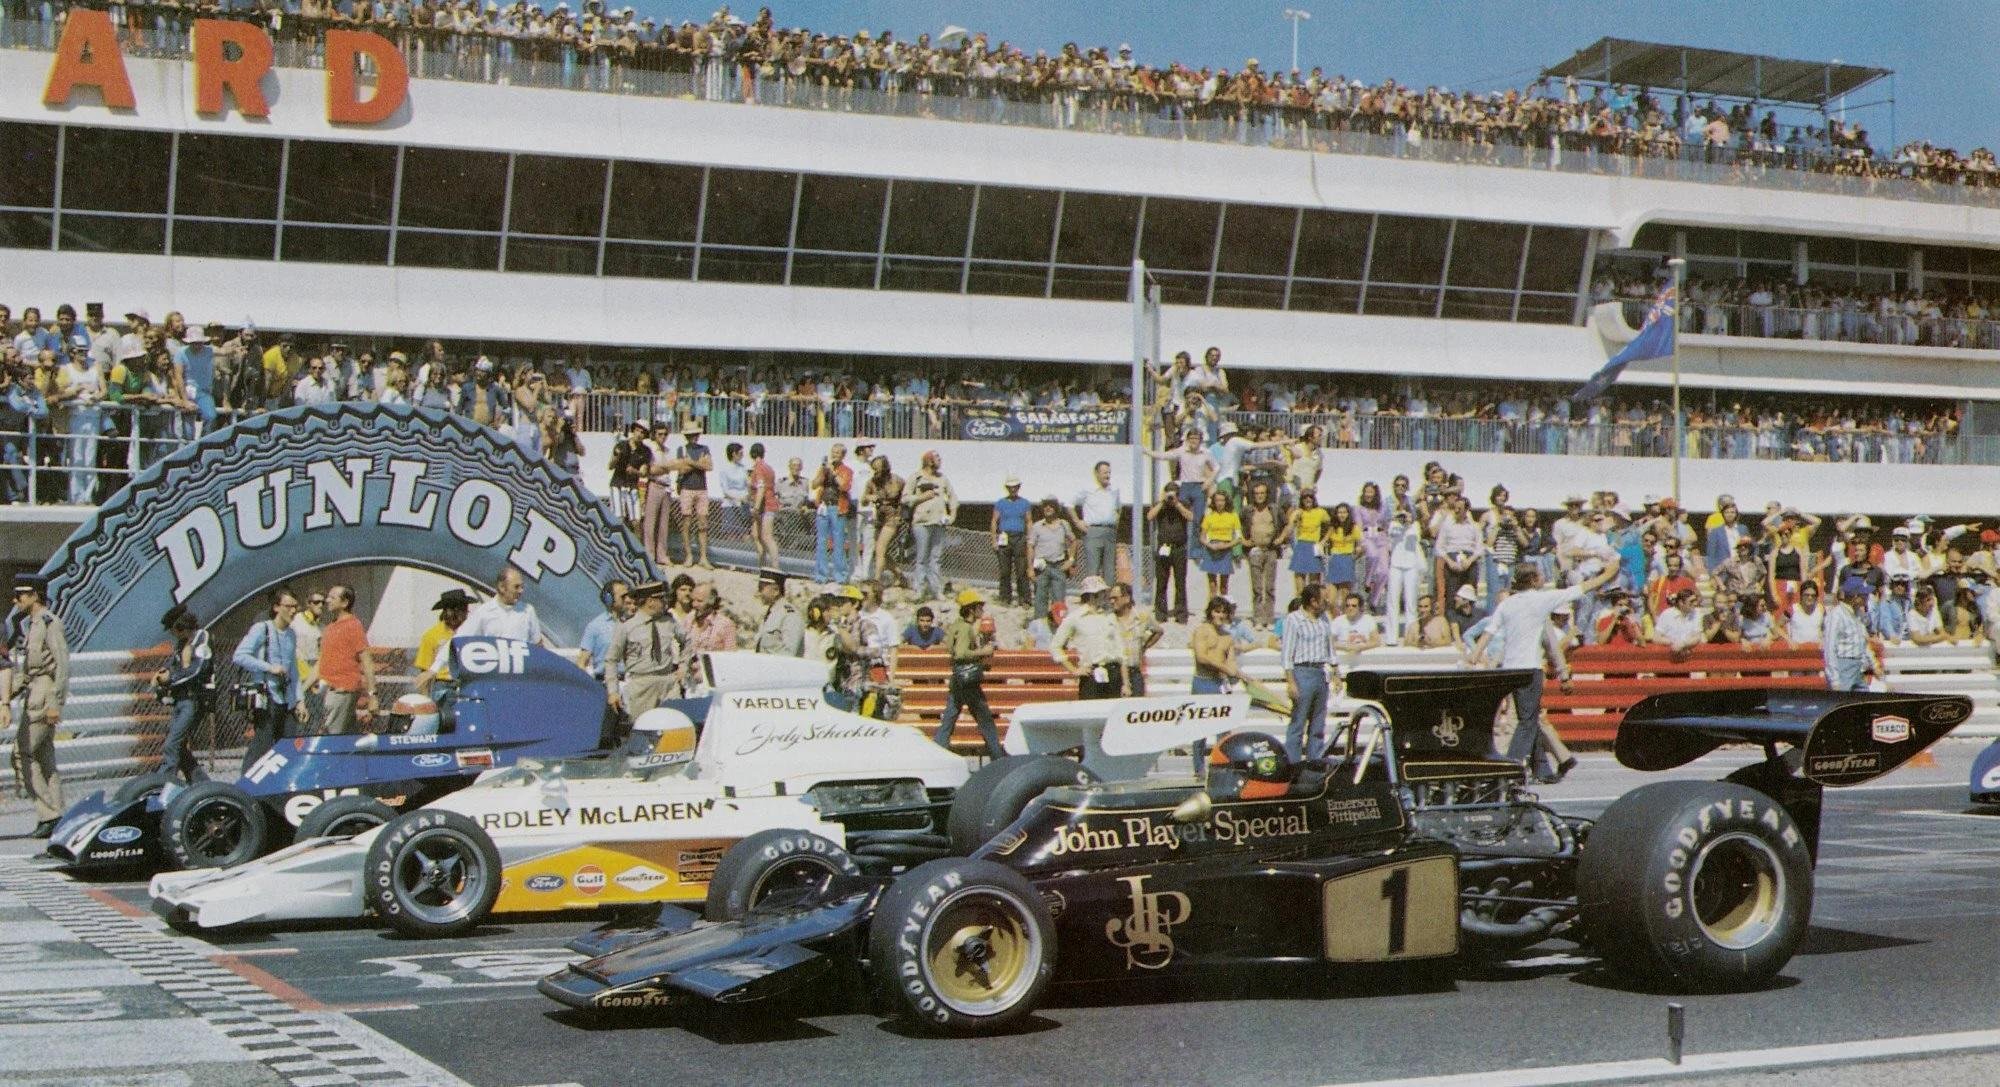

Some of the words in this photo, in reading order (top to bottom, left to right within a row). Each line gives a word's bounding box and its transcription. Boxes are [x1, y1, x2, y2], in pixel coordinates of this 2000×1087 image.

[970, 418, 1005, 436] Ford
[154, 456, 579, 604] DUNLOP
[460, 638, 530, 674] elf
[732, 697, 820, 711] YARDLEY
[1928, 704, 1960, 719] Ford
[1126, 702, 1232, 725] GOODYEAR
[1876, 724, 1906, 733] TEXACO
[389, 734, 438, 745] STEWART
[735, 722, 804, 756] Jody
[418, 754, 445, 766] Ford
[638, 752, 682, 766] JODY
[1813, 755, 1877, 774] GOODYEAR
[580, 802, 704, 826] McLAREN
[1327, 798, 1378, 812] Emerson
[106, 829, 133, 840] Ford
[1050, 816, 1120, 856] John
[1124, 816, 1212, 850] Player
[1214, 806, 1310, 844] Special
[90, 847, 144, 860] GOODYEAR
[1664, 799, 1799, 918] GOODYEAR
[378, 814, 447, 915] GOODYEAR
[531, 876, 560, 888] Ford
[577, 875, 603, 884] Gulf
[1380, 867, 1409, 955] 1
[901, 872, 963, 1023] GOODYEAR
